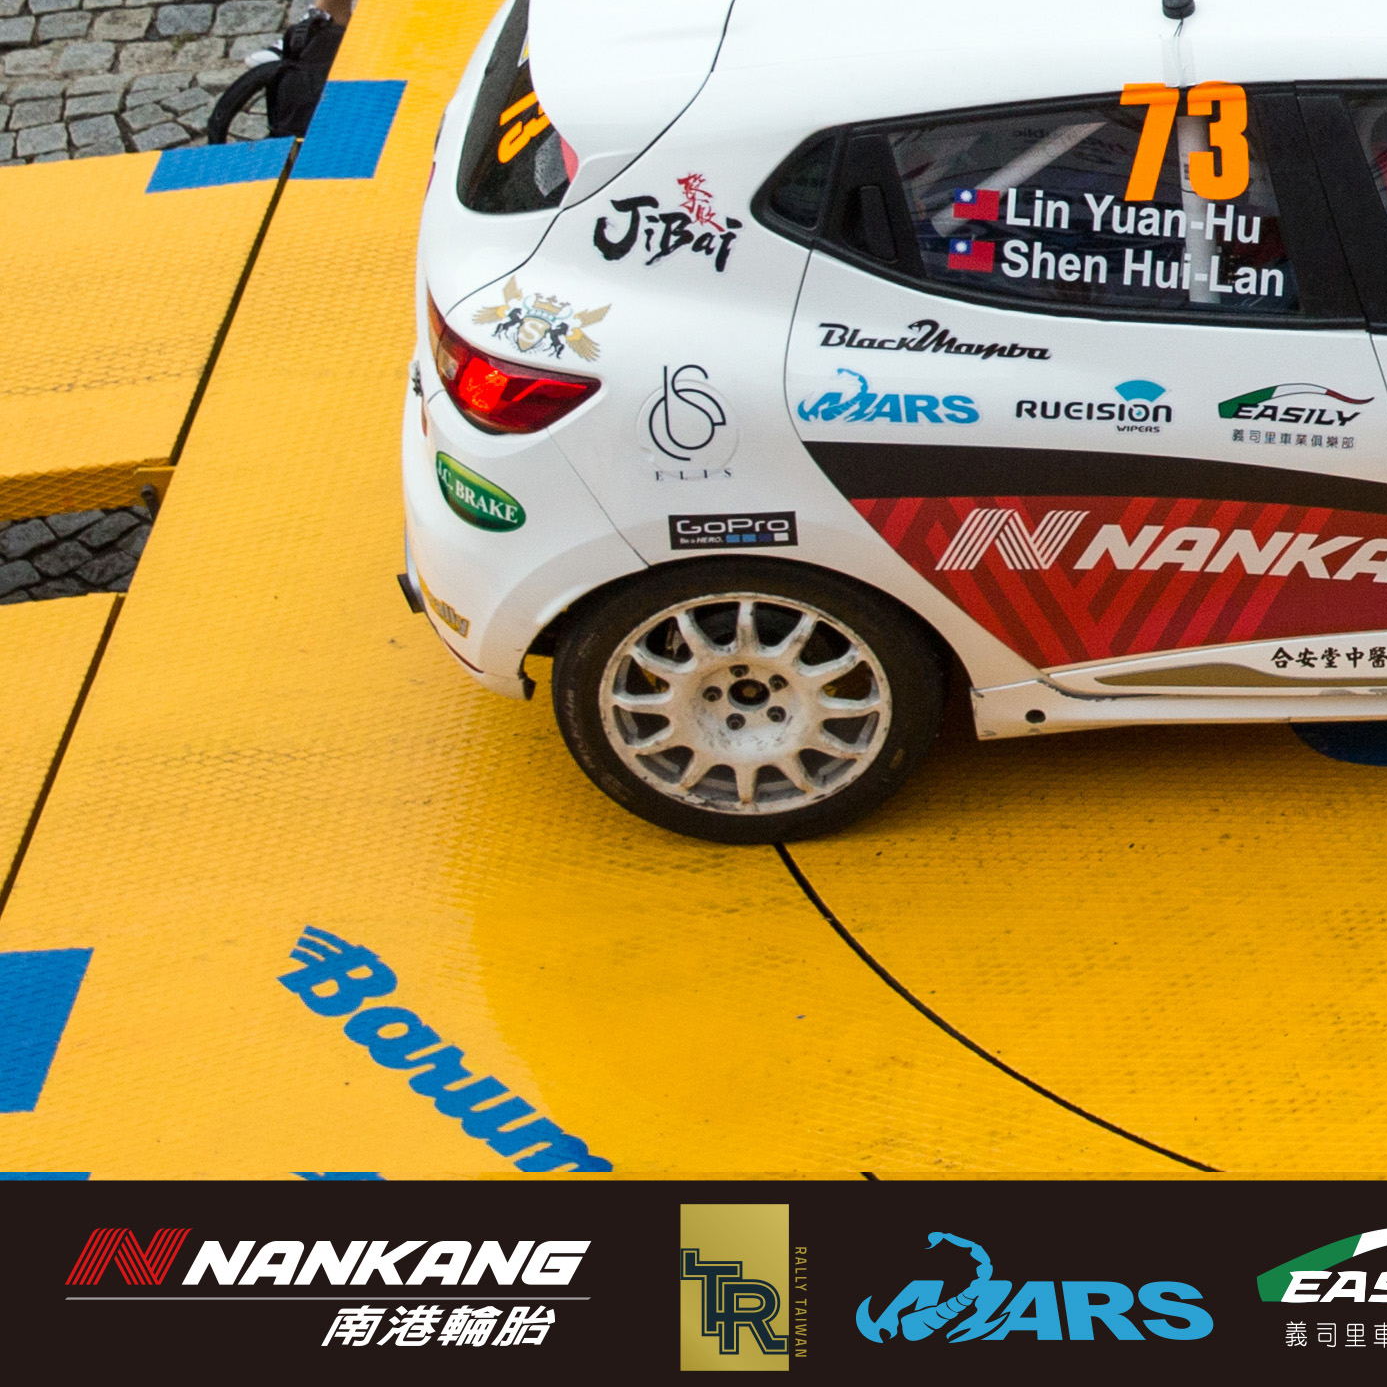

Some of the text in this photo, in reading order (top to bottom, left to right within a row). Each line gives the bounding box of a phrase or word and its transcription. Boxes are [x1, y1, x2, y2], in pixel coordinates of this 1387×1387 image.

[1119, 80, 1250, 202] 73
[593, 194, 743, 273] JiBai
[1005, 187, 1261, 244] Lin Yuan-Hu
[1001, 239, 1284, 297] Shen Hui-Lan
[817, 319, 1052, 361] BlackMamba
[1116, 425, 1161, 435] WIPERS
[1231, 403, 1362, 428] EASILY
[655, 470, 732, 481] ELIS
[454, 482, 520, 524] BRAKE
[676, 518, 790, 535] GoPro
